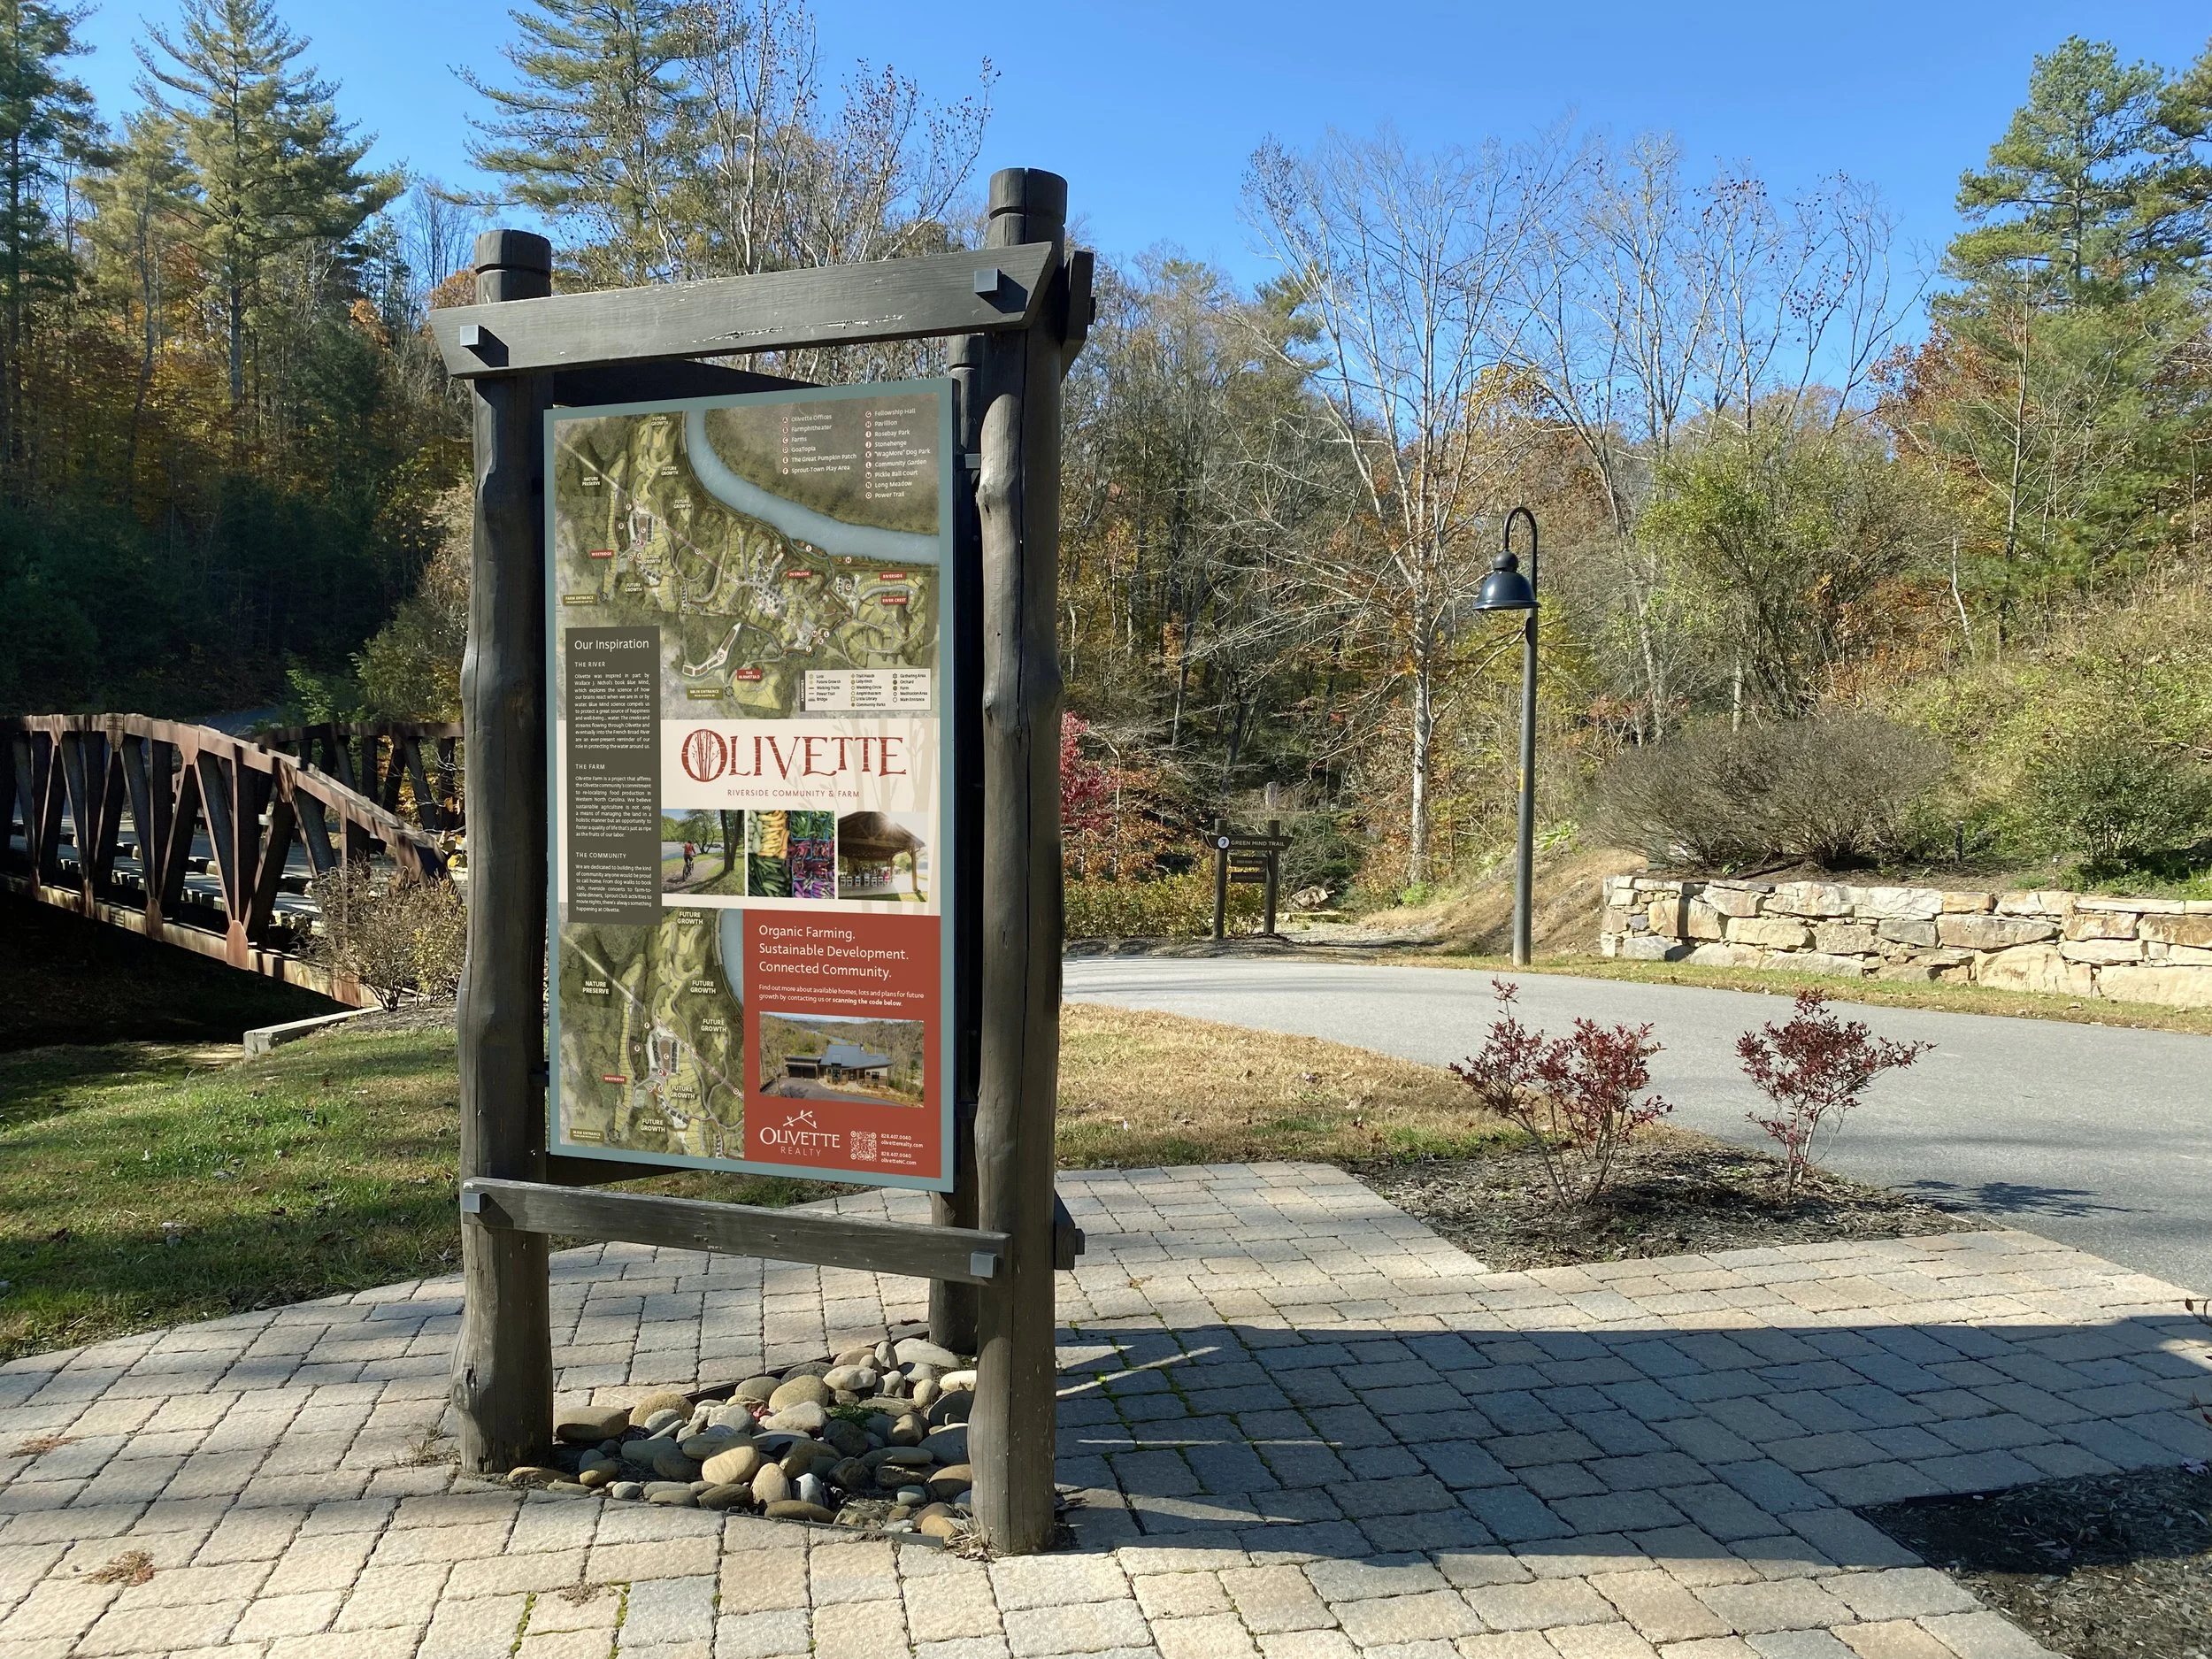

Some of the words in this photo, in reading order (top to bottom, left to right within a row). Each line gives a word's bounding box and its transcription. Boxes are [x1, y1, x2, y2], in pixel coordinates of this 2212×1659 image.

[575, 640, 593, 649] Our
[596, 639, 649, 652] Inspiration
[681, 728, 906, 783] OLIVETTE
[759, 925, 803, 939] Organic
[806, 927, 856, 942] Farming.
[759, 943, 824, 956] Sustainable
[827, 946, 909, 962] Development.
[759, 962, 819, 974] Connected
[823, 964, 891, 981] Community.
[760, 1127, 840, 1148] OLIVETTE
[881, 1140, 923, 1148] olivetterealty.com
[781, 1147, 821, 1157] REALTY
